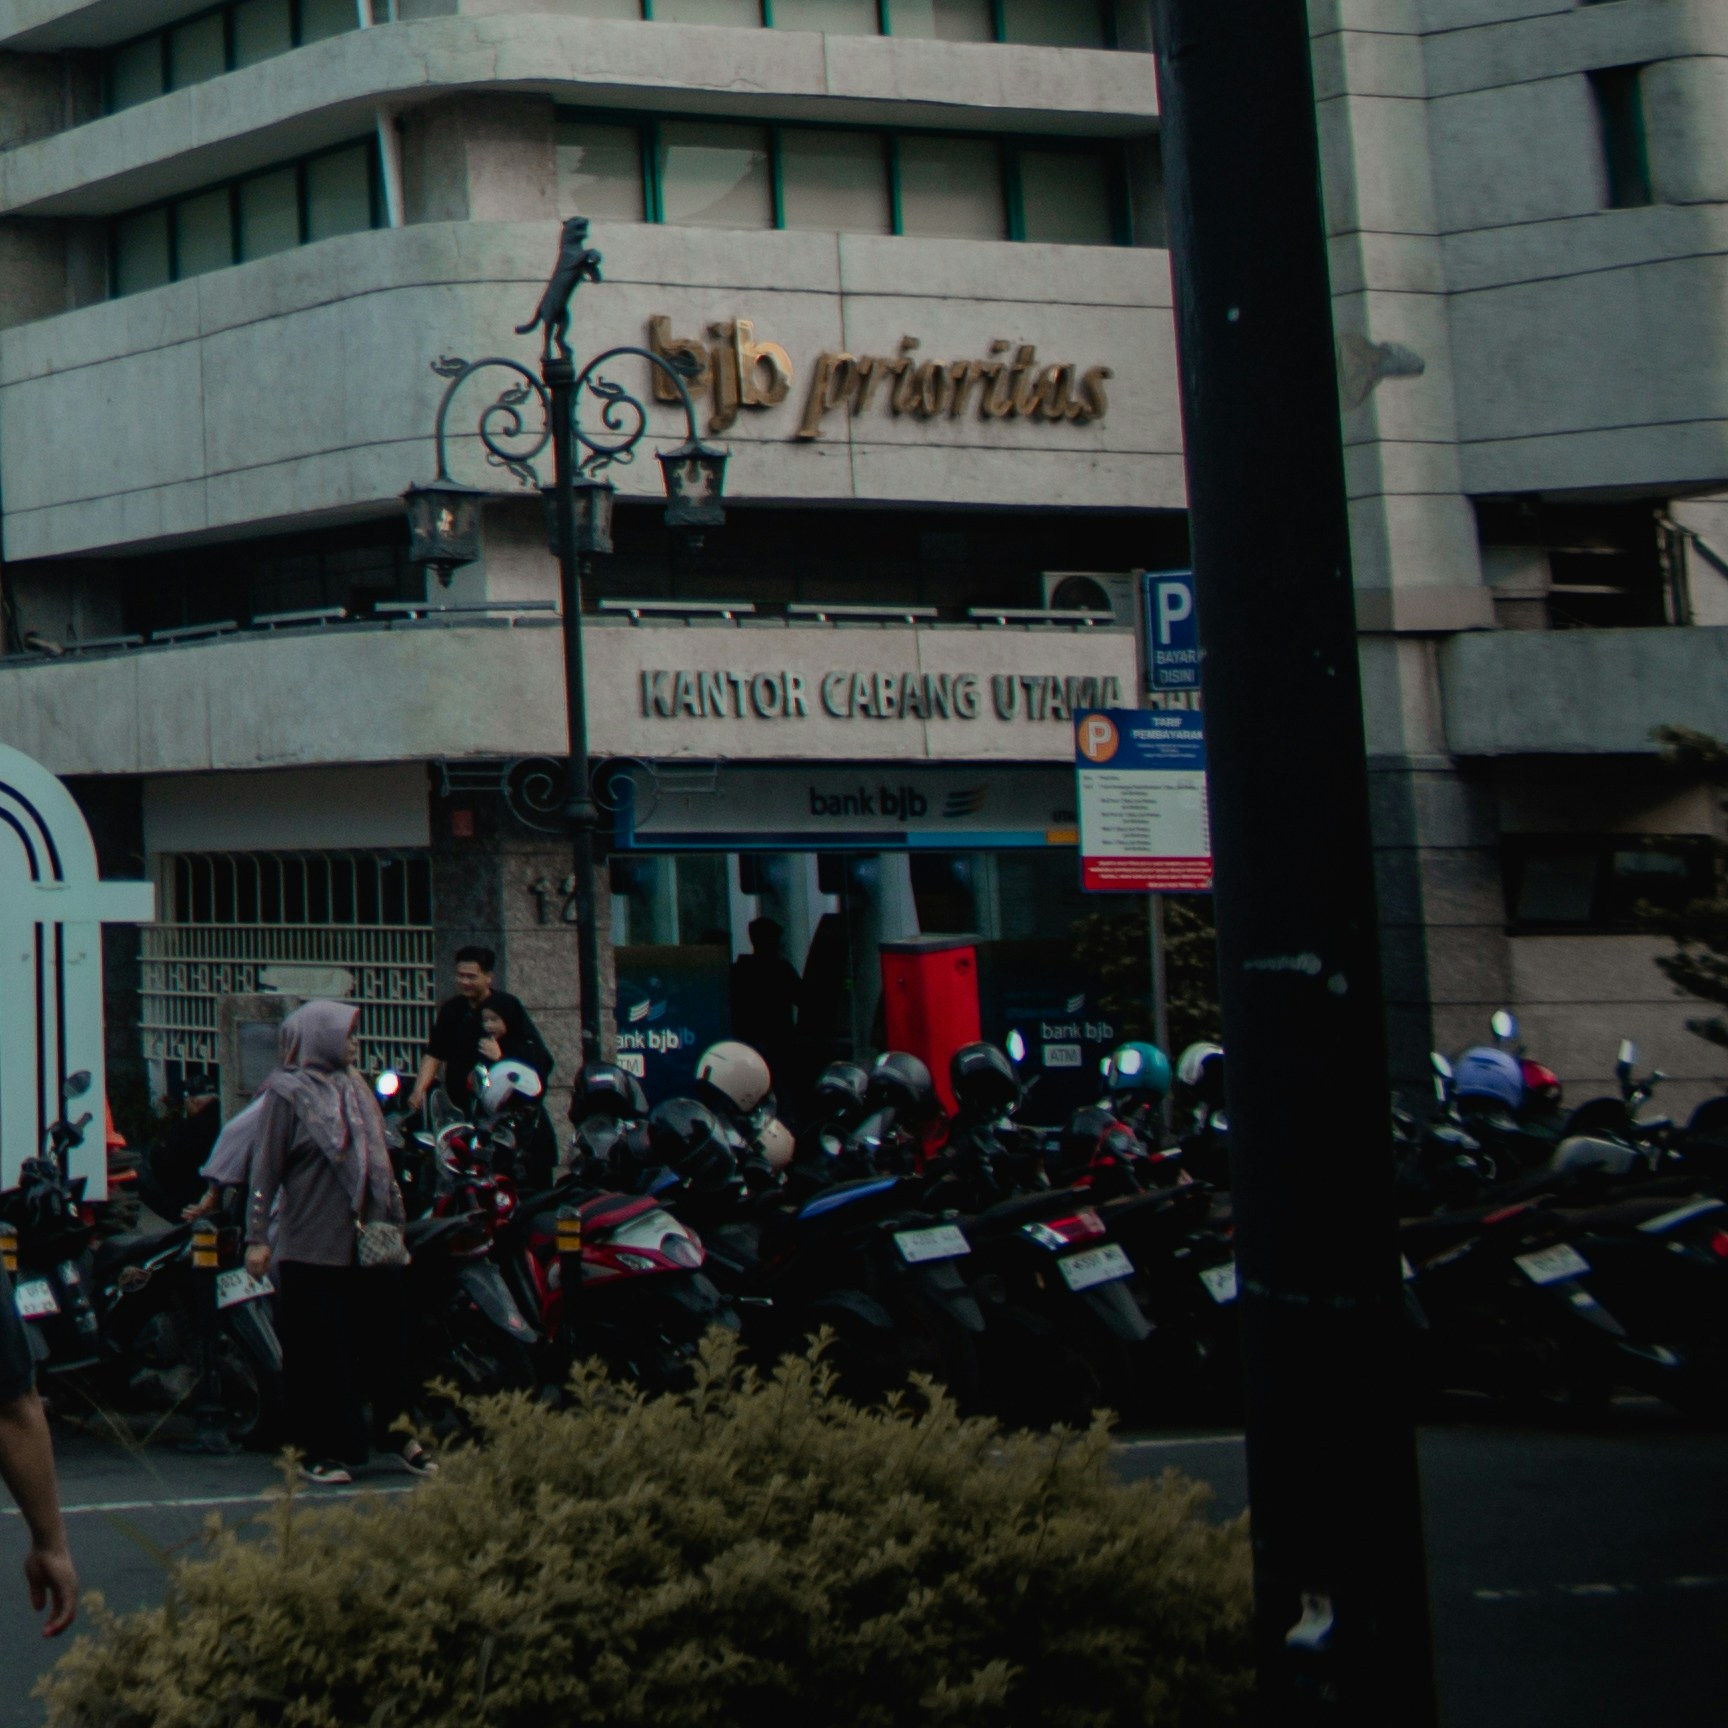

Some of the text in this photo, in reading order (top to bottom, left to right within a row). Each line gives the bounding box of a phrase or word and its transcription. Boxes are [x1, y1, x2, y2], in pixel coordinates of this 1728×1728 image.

[647, 315, 1112, 441] bjb prioritas
[1156, 582, 1193, 645] P
[1155, 649, 1195, 665] BAYAR
[1158, 668, 1195, 683] DISINI
[643, 670, 1122, 722] KANTOR CABANG UTAMA
[1086, 721, 1112, 758] P
[809, 786, 928, 822] bank bjb
[616, 1028, 679, 1055] ank bjb
[1041, 1022, 1114, 1044] bank bjb
[618, 1058, 640, 1072] TM
[1049, 1048, 1078, 1062] ATM
